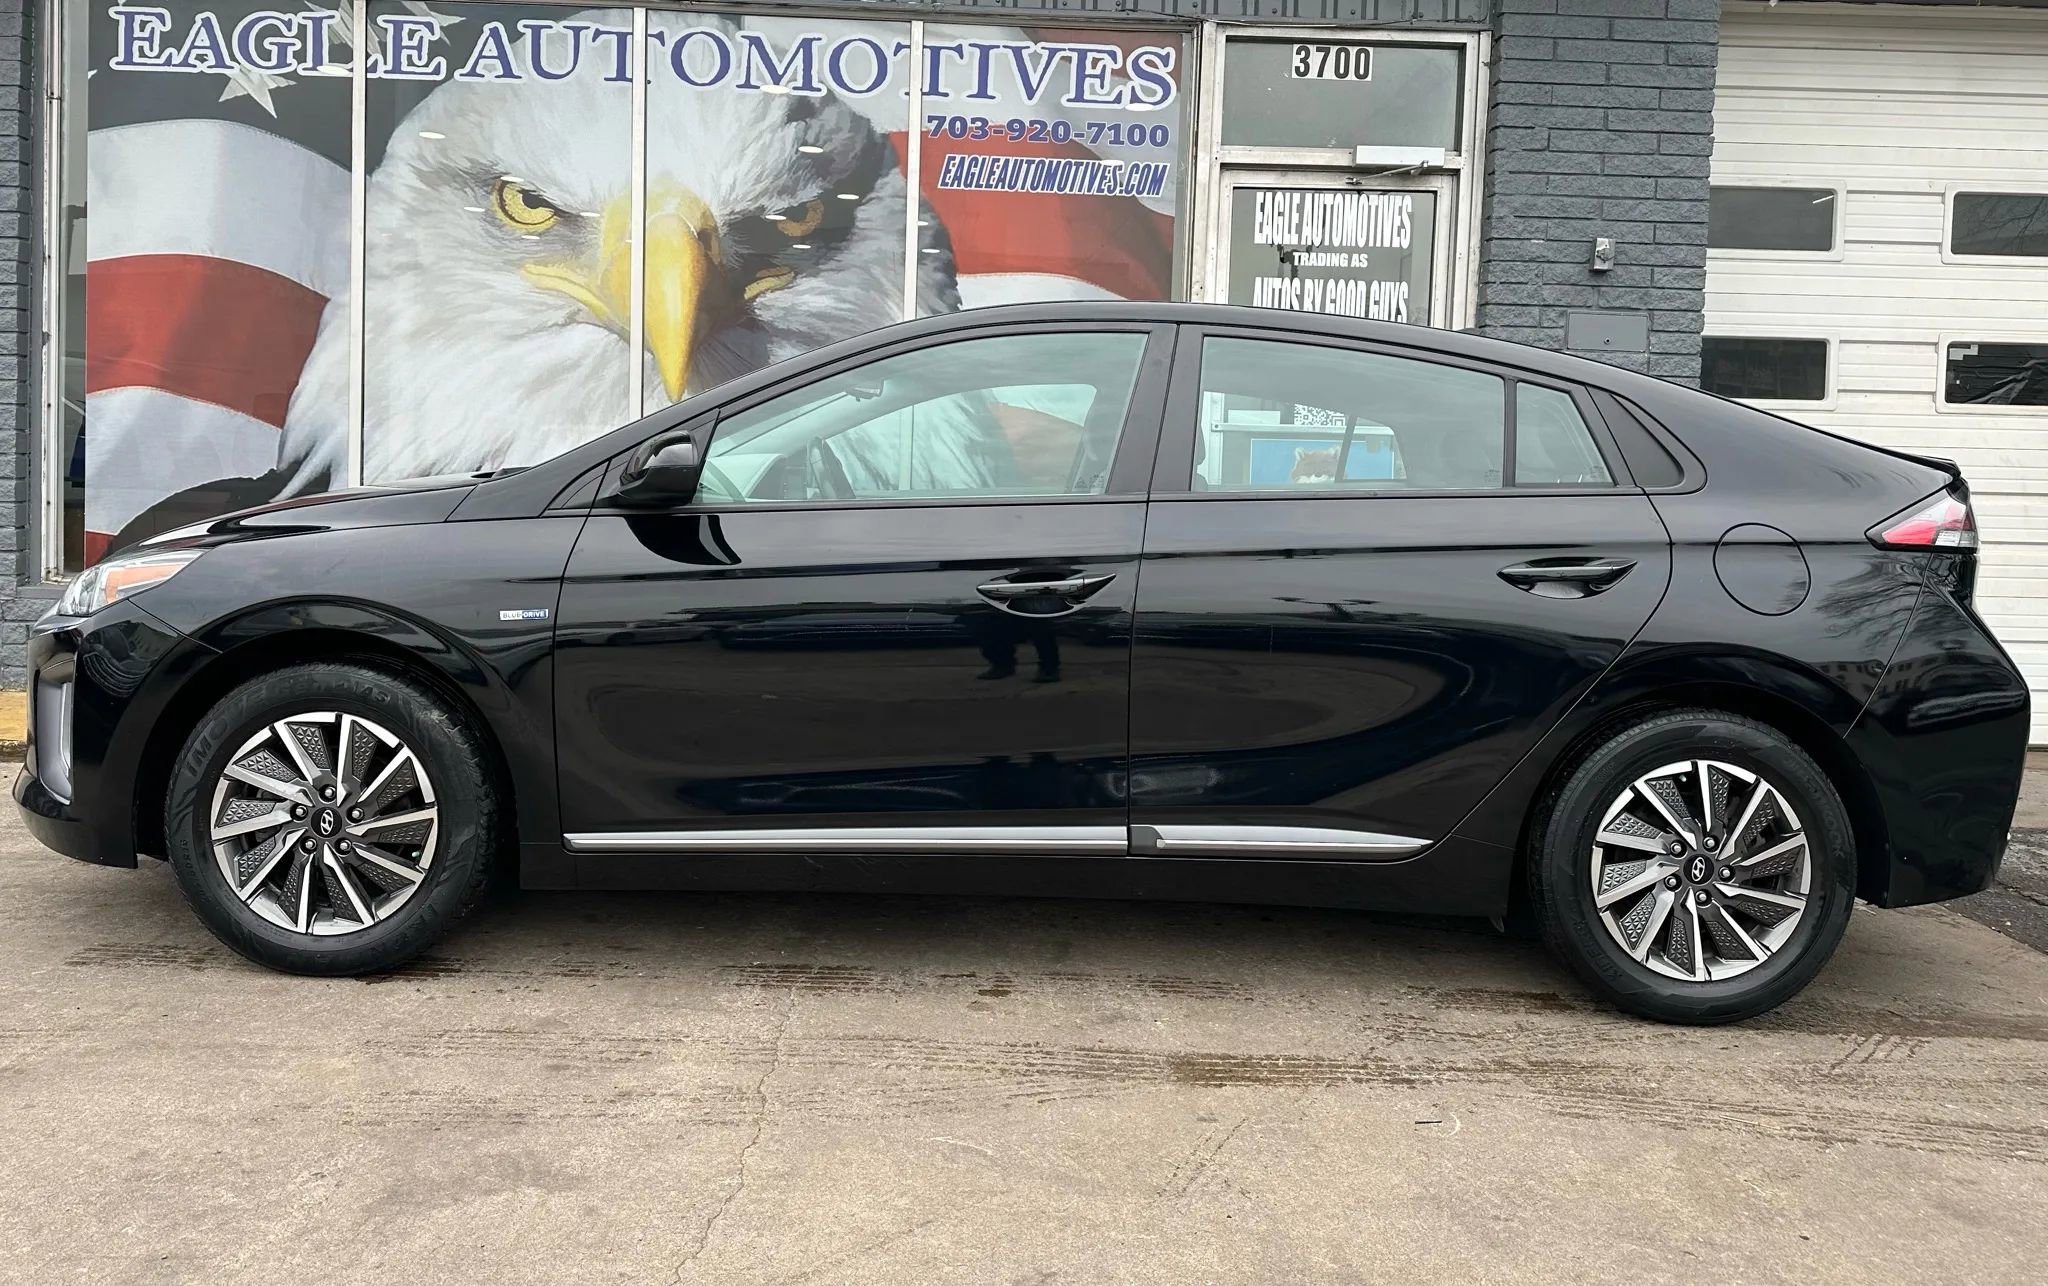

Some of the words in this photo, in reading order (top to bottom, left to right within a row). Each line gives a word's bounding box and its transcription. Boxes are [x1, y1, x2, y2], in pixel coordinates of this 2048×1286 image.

[111, 7, 445, 79] EAGLE
[455, 20, 1178, 110] AUTOMOTIVES
[1294, 45, 1371, 80] 3700
[927, 115, 1170, 147] 703-920-7100
[939, 154, 1169, 196] EAGLEAUTOMOTIVES.COM
[1254, 191, 1301, 245] EAGLE
[1301, 193, 1412, 249] AUTOMOTIVES
[1293, 252, 1348, 267] TRADING
[1350, 253, 1368, 268] AS
[1253, 277, 1300, 310] AUTOS
[1303, 279, 1323, 312] BY
[1325, 279, 1367, 318] GOOD
[1368, 280, 1408, 323] GUYS
